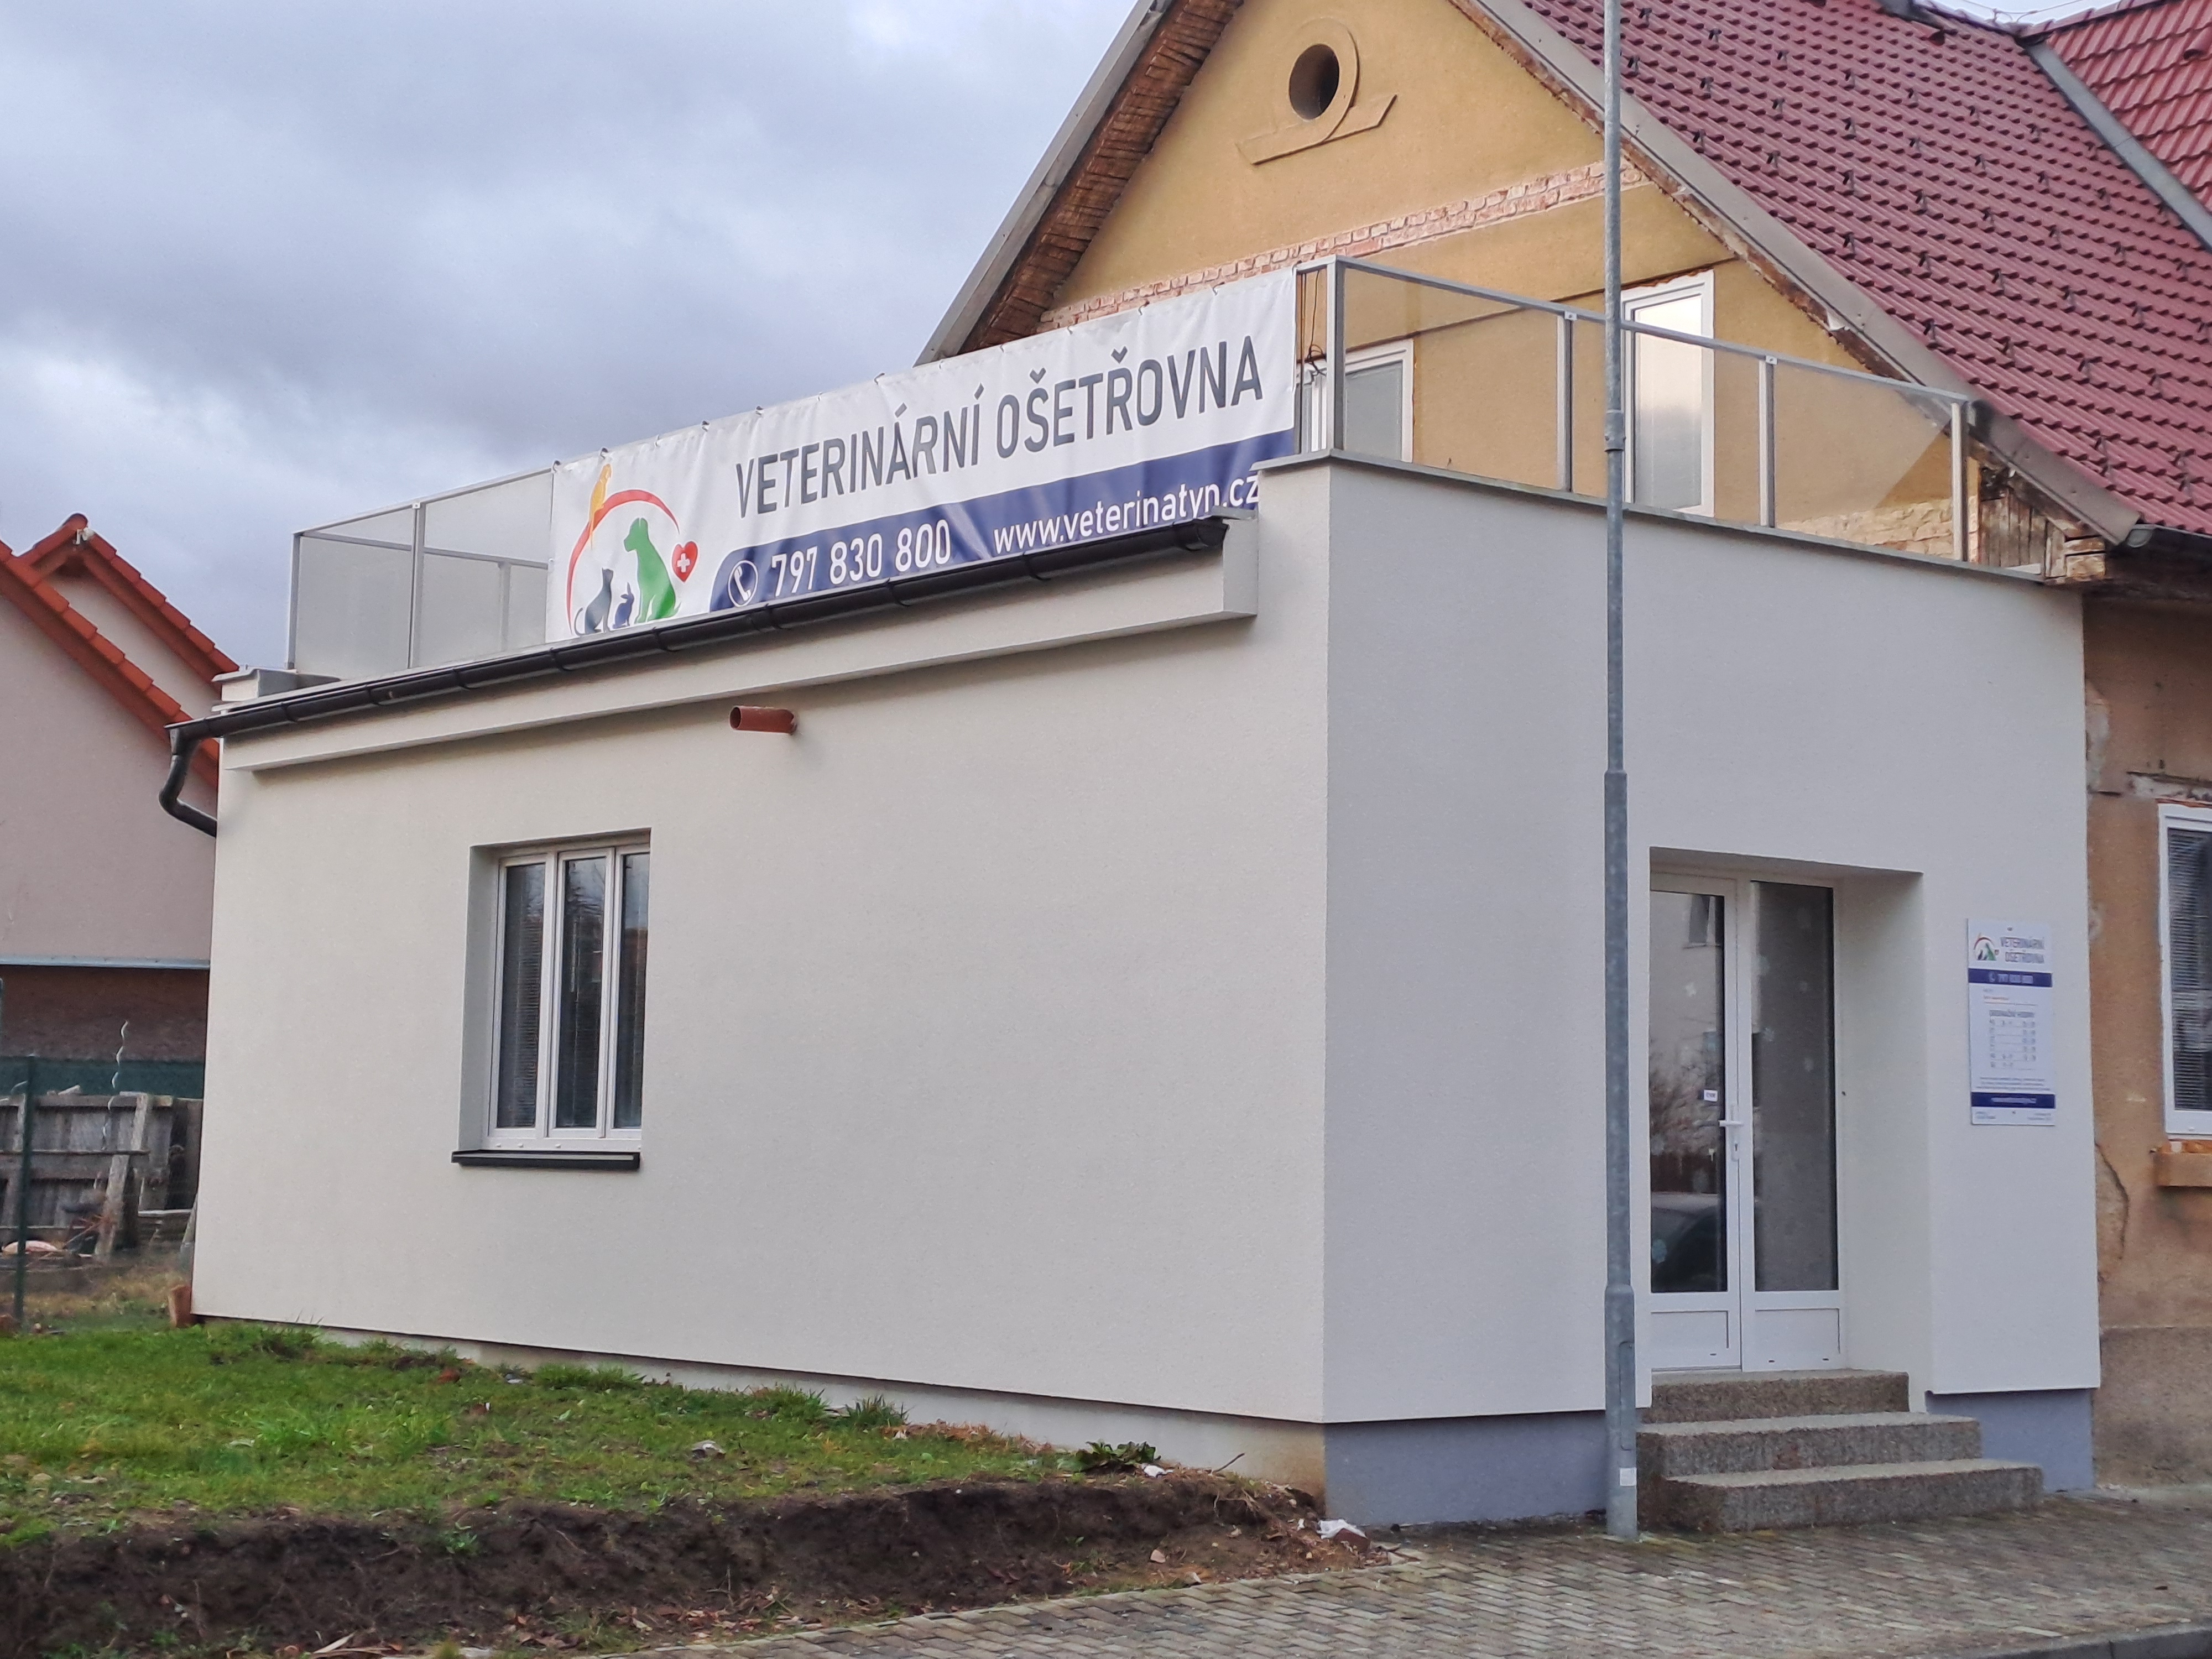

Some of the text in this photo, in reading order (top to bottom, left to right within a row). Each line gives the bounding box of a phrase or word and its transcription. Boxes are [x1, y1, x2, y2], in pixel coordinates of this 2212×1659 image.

[736, 335, 1263, 518] VETERINÁRNÍ OŠETŘOVNA
[994, 475, 1259, 554] www.veterinatyn.cz
[771, 519, 951, 597] 797 830 800
